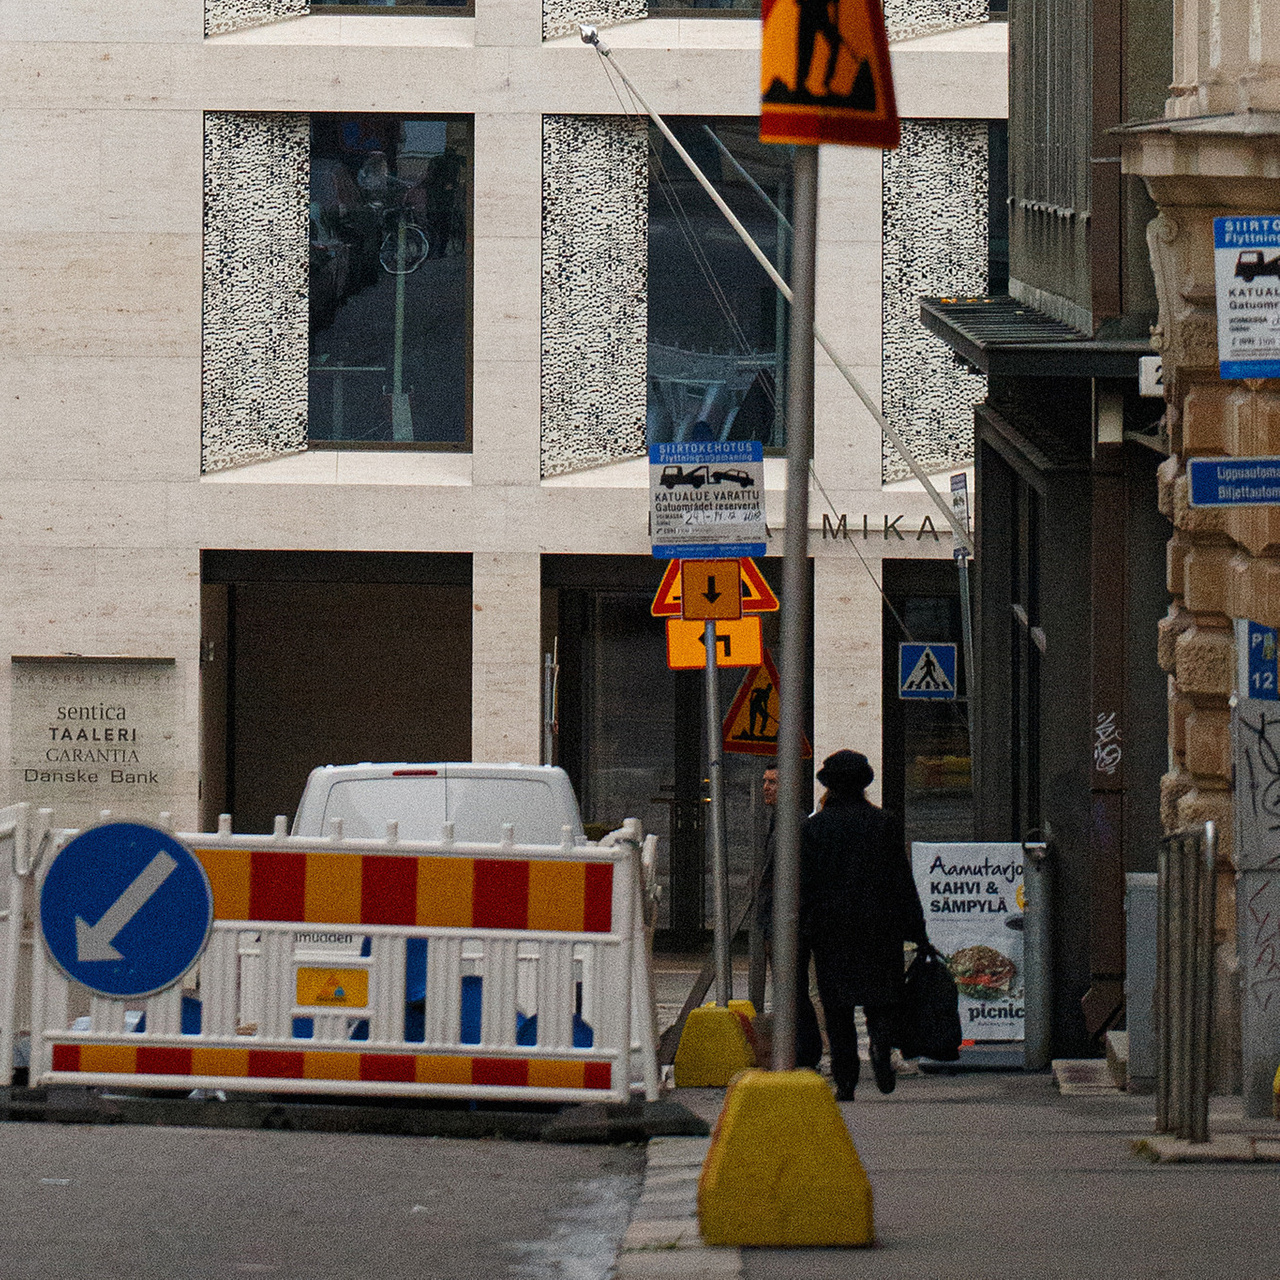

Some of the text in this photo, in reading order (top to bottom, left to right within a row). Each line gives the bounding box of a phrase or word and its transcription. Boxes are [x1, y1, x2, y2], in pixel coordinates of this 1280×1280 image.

[659, 443, 753, 454] SIIRTOKEHOTUS
[655, 490, 760, 502] KATUALUE VARATTU
[655, 501, 760, 513] Gatuområdet reserverat
[15, 674, 141, 685] KASARMIKATU
[1252, 671, 1274, 690] 12
[57, 702, 127, 721] sentica
[48, 727, 137, 742] TAALERI
[46, 748, 140, 763] GARANTIA
[24, 769, 159, 784] Danske Bank
[930, 881, 999, 895] KAHVI &
[930, 897, 1008, 913] SÄMPYLÄ
[968, 1003, 1025, 1022] picnic
